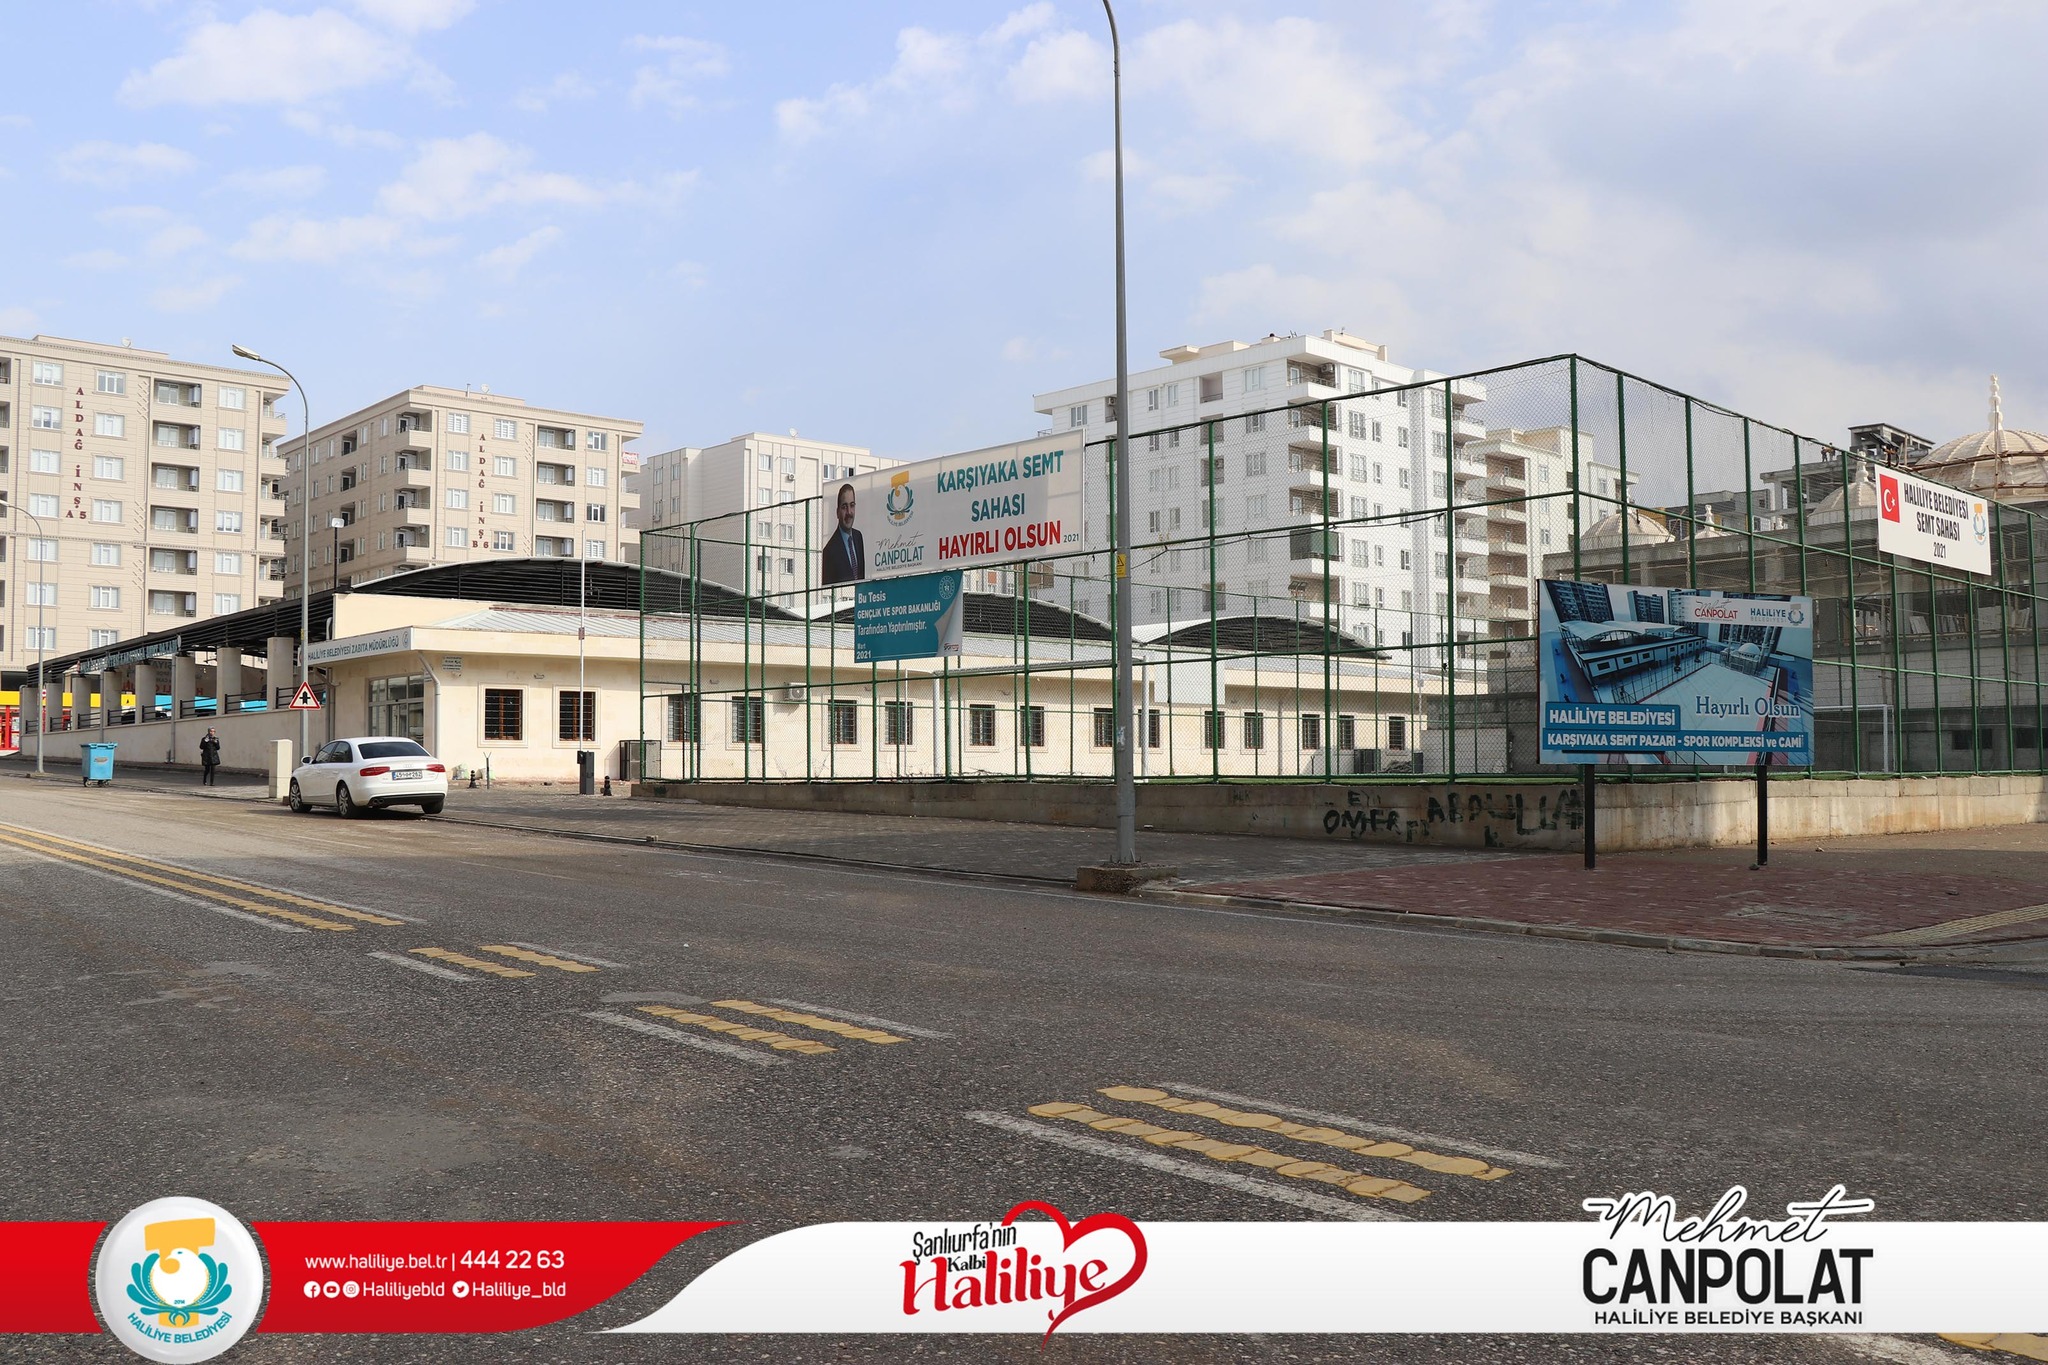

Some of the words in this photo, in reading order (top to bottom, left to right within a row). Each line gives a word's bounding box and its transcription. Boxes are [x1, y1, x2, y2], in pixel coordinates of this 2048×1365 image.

[74, 387, 84, 450] ALDAĞ
[478, 434, 486, 488] ALDAĞ
[937, 459, 1018, 493] KARŞIYAKA
[1023, 450, 1064, 478] SEMT
[971, 493, 1025, 522] SAHASI
[1903, 482, 1933, 510] HALİLİYE
[1933, 492, 1969, 520] BELEDİYESİ
[66, 510, 74, 518] A
[79, 511, 87, 519] 5
[1916, 511, 1935, 536] SEMT
[1935, 518, 1961, 541] SAHASI
[875, 530, 924, 550] Mehmet
[939, 530, 999, 560] HAYIRLI
[1004, 520, 1061, 551] OLSUN
[1064, 534, 1079, 543] 2021
[875, 546, 924, 566] CANPOLAT
[1933, 542, 1947, 559] 2021
[858, 593, 866, 604] Bu
[868, 591, 886, 602] Tesis
[882, 607, 891, 616] VE
[891, 605, 907, 615] SPOR
[908, 600, 940, 614] BAKANLIĞI
[1695, 608, 1738, 619] CANPOLAT
[857, 623, 887, 636] Tarafından
[326, 643, 352, 658] BELEDİYESİ
[351, 643, 369, 654] ZABITA
[857, 650, 871, 659] 2021
[1549, 707, 1606, 724] HALİLİYE
[1608, 708, 1676, 726] BELEDİYESİ
[1696, 696, 1749, 718] Hayırlı
[1754, 697, 1800, 716] Olsun
[1547, 733, 1608, 747] KARŞIYAKA
[1610, 734, 1638, 746] SEMT
[1640, 735, 1676, 746] PAZARI
[1683, 735, 1710, 747] SPOR
[1711, 734, 1765, 748] KOMPLEKSİ
[1766, 738, 1777, 747] ve
